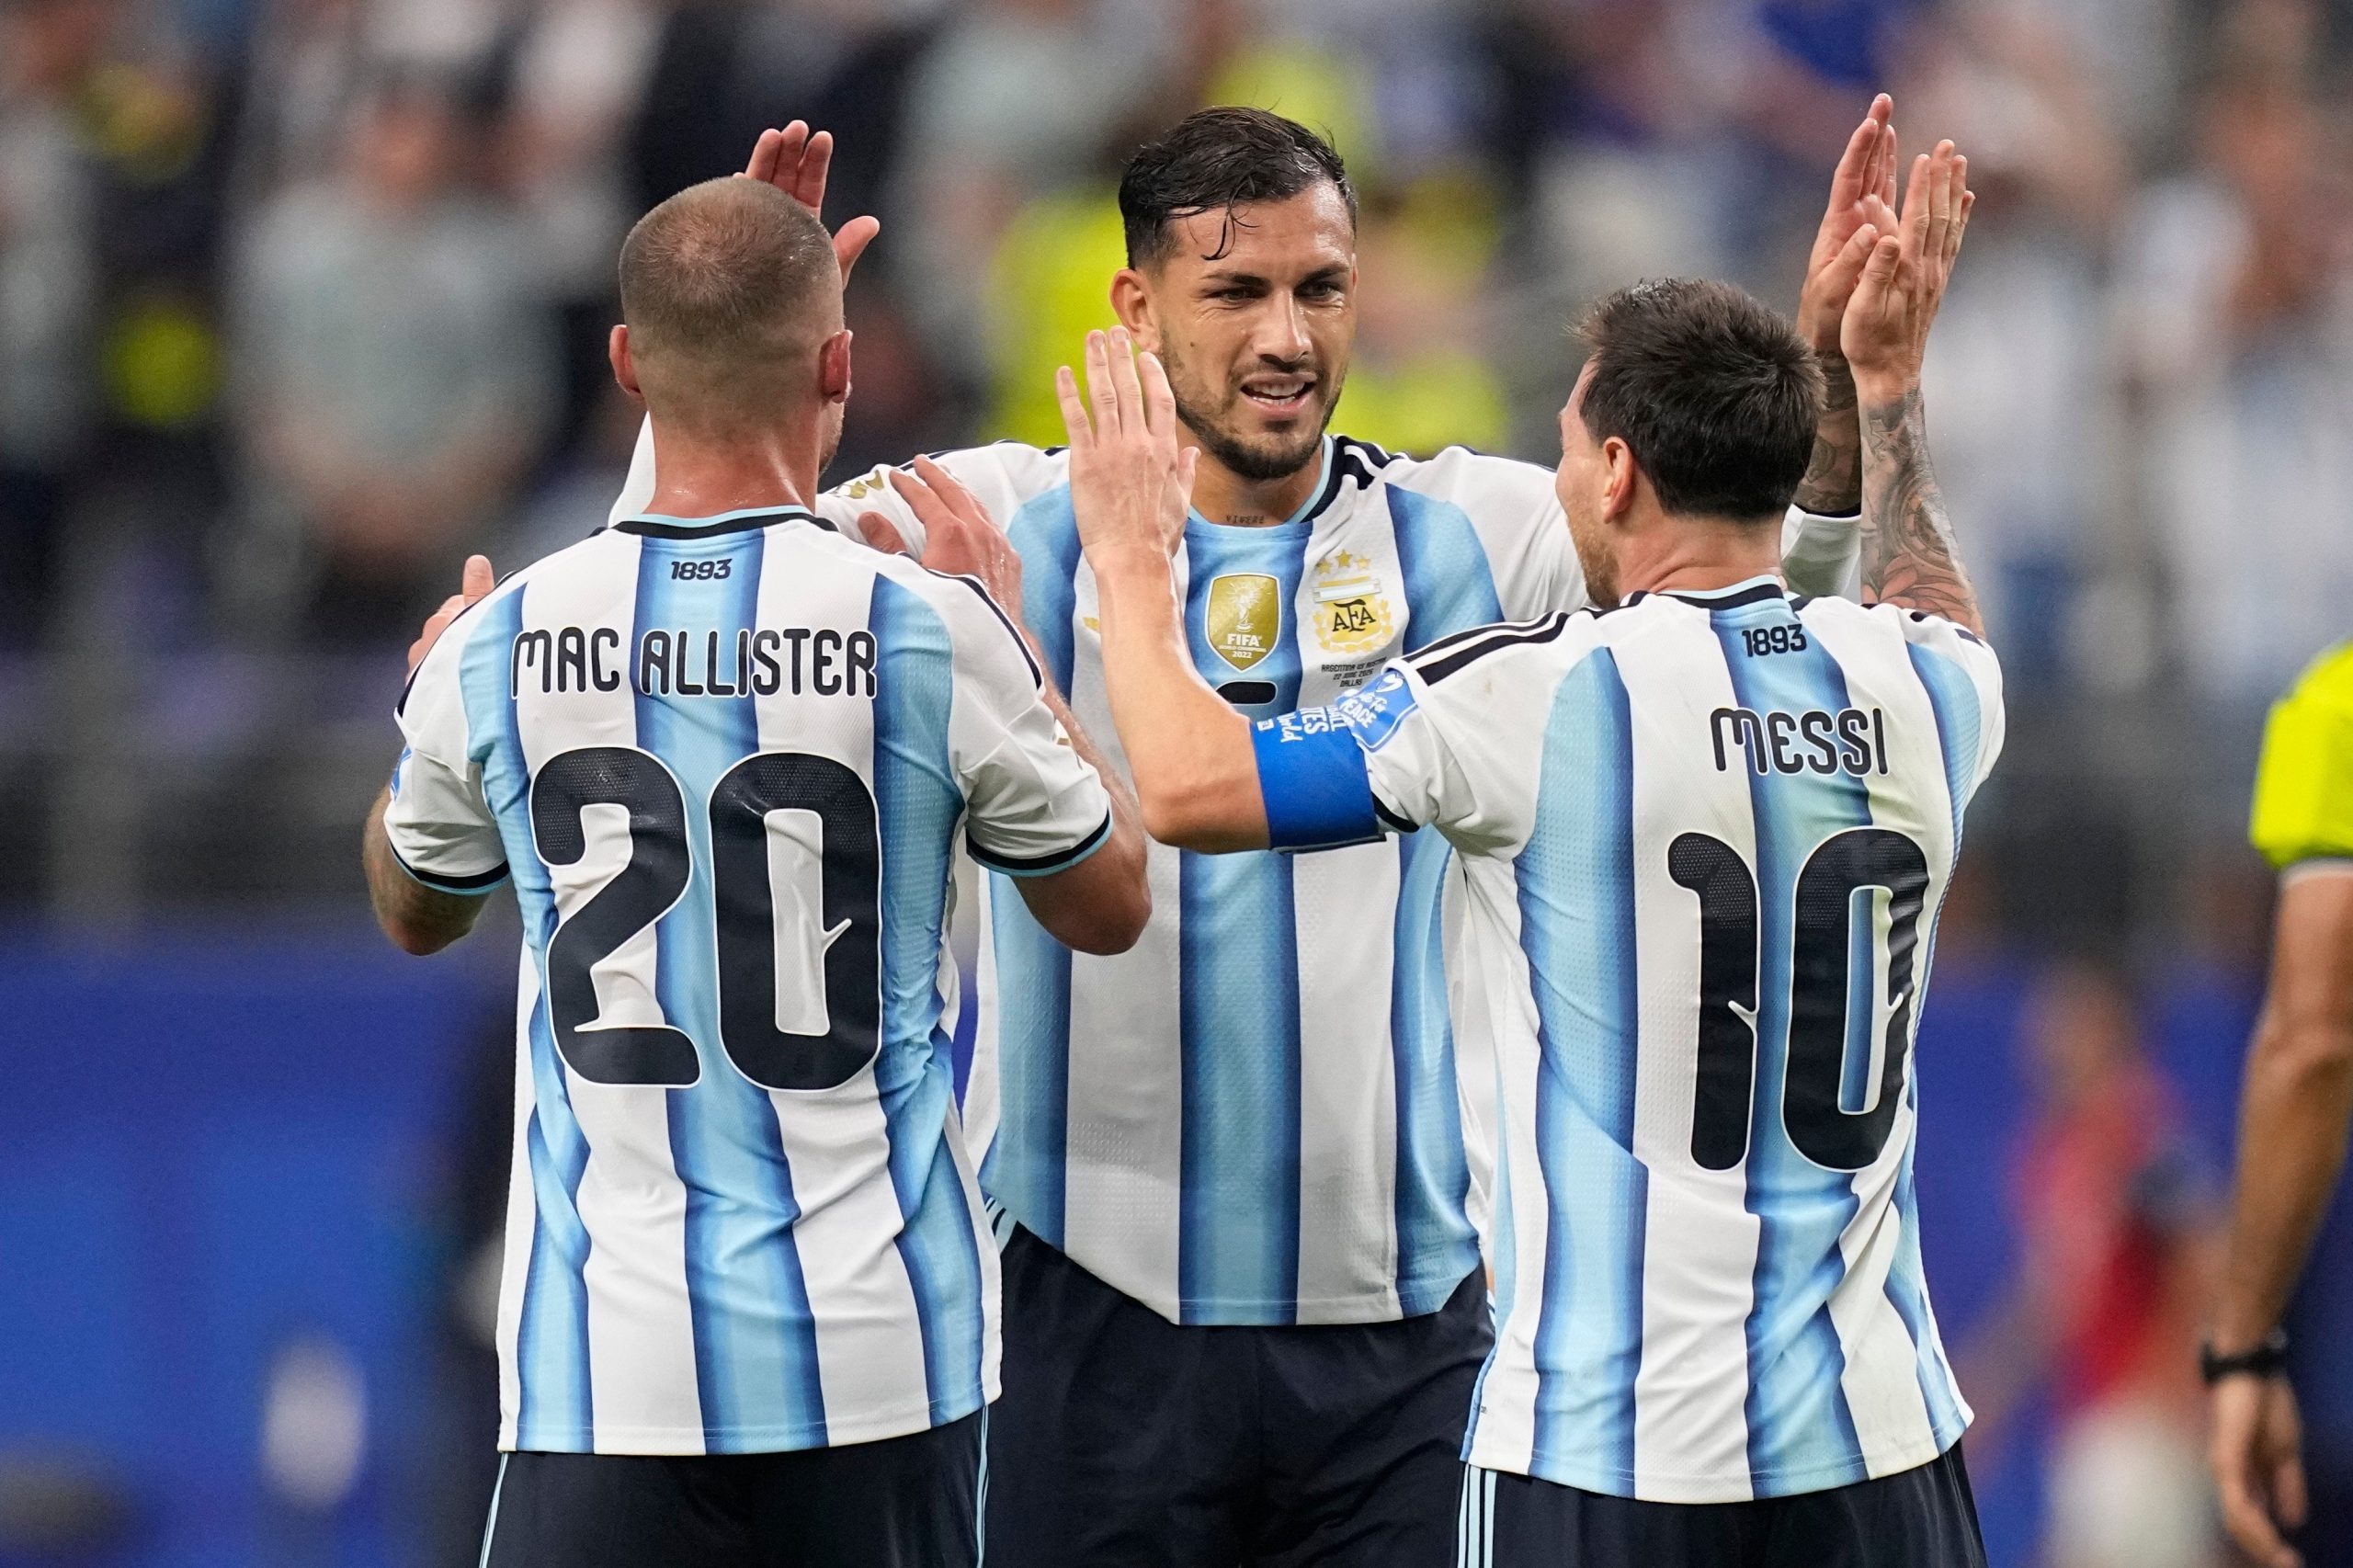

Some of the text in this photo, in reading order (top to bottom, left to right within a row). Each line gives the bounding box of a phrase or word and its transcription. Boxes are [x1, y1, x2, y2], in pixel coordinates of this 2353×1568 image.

[671, 557, 732, 582] 1893
[1227, 634, 1260, 647] FIFA
[1332, 598, 1376, 632] AFA
[512, 628, 878, 699] MAC ALLISTER
[1743, 625, 1807, 658] 1893
[1711, 707, 1892, 777] MESSI
[530, 747, 882, 1091] 20
[1667, 830, 1928, 1174] 10
